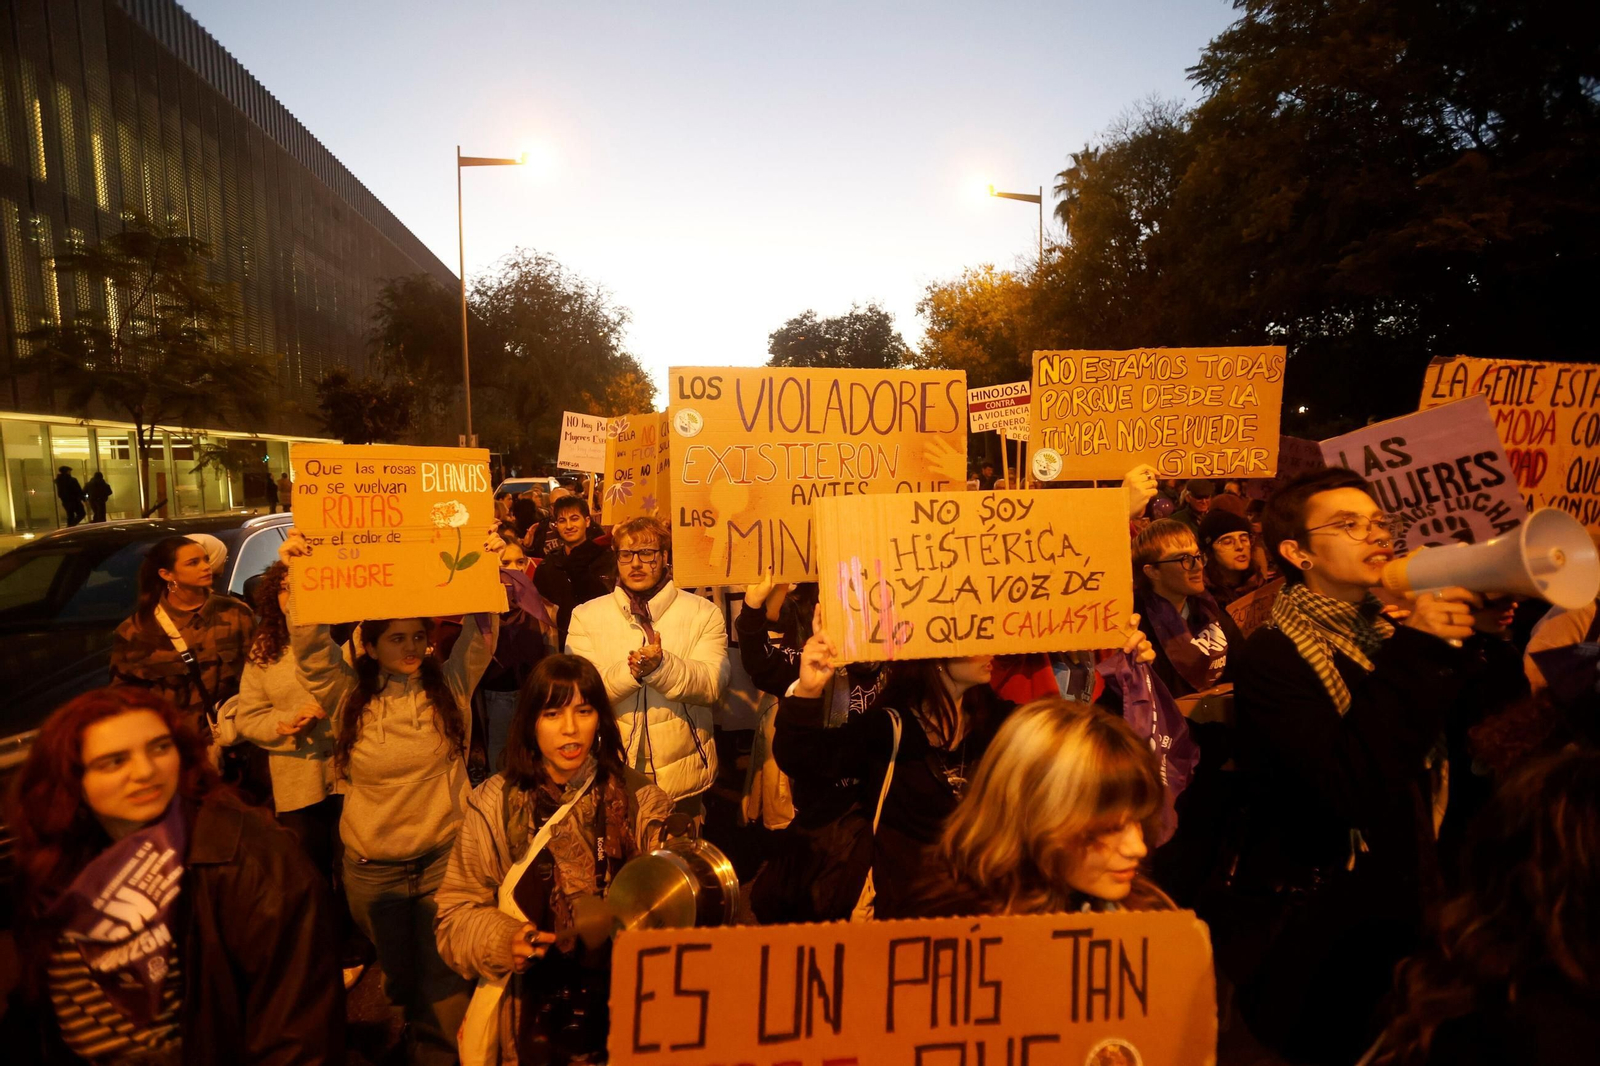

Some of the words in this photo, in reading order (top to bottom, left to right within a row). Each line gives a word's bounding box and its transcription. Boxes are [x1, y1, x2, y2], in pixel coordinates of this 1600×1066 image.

[1038, 353, 1077, 387] NO
[1080, 352, 1188, 384] ESTAMOS
[1197, 353, 1285, 383] TODAS
[1431, 362, 1469, 398] LA
[1478, 364, 1546, 406] GENTE
[678, 375, 723, 401] LOS
[735, 376, 964, 436] VIOLADORES
[971, 384, 1028, 402] HINOJOSA
[985, 398, 1016, 410] CONTRA
[1041, 384, 1134, 421] PORQUE
[1141, 384, 1225, 412] DESDE
[1228, 383, 1261, 409] LA
[566, 415, 579, 428] NO
[972, 413, 984, 422] LA
[985, 406, 1030, 419] VIOLENCIA
[978, 422, 990, 431] DE
[1571, 411, 1600, 449] CO
[618, 430, 636, 442] ELLA
[641, 425, 656, 444] NO
[1041, 418, 1111, 457] TUMBA
[1117, 416, 1148, 453] NO
[1149, 415, 1179, 449] SE
[1181, 414, 1258, 448] PUEDE
[305, 459, 343, 477] Que
[355, 462, 375, 475] las
[383, 464, 417, 475] rosas
[421, 462, 488, 493] BLANCAS
[614, 467, 634, 480] QUE
[640, 463, 651, 476] NO
[682, 442, 901, 485] EXISTIERON
[1157, 448, 1270, 478] GRITAR
[1505, 447, 1548, 489] DAD
[298, 483, 319, 495] no
[327, 481, 345, 495] se
[353, 478, 407, 495] vuelvan
[322, 494, 405, 529] ROJAS
[910, 499, 960, 525] NO
[976, 492, 1035, 525] SOY
[305, 536, 325, 546] por
[331, 531, 345, 546] el
[352, 529, 383, 545] color
[386, 530, 401, 544] de
[679, 506, 716, 528] LAS
[725, 518, 819, 578] MIN
[302, 563, 395, 591] SANGRE
[926, 574, 982, 604] LA
[986, 574, 1052, 604] VOZ
[1060, 571, 1106, 596] DE
[868, 619, 915, 646] LO
[925, 614, 995, 644] QUE
[1001, 598, 1120, 639] CALLASTE
[632, 943, 713, 1054] ES
[758, 943, 845, 1046] UN
[885, 923, 1003, 1034] PAÍS
[1051, 927, 1149, 1023] TAN
